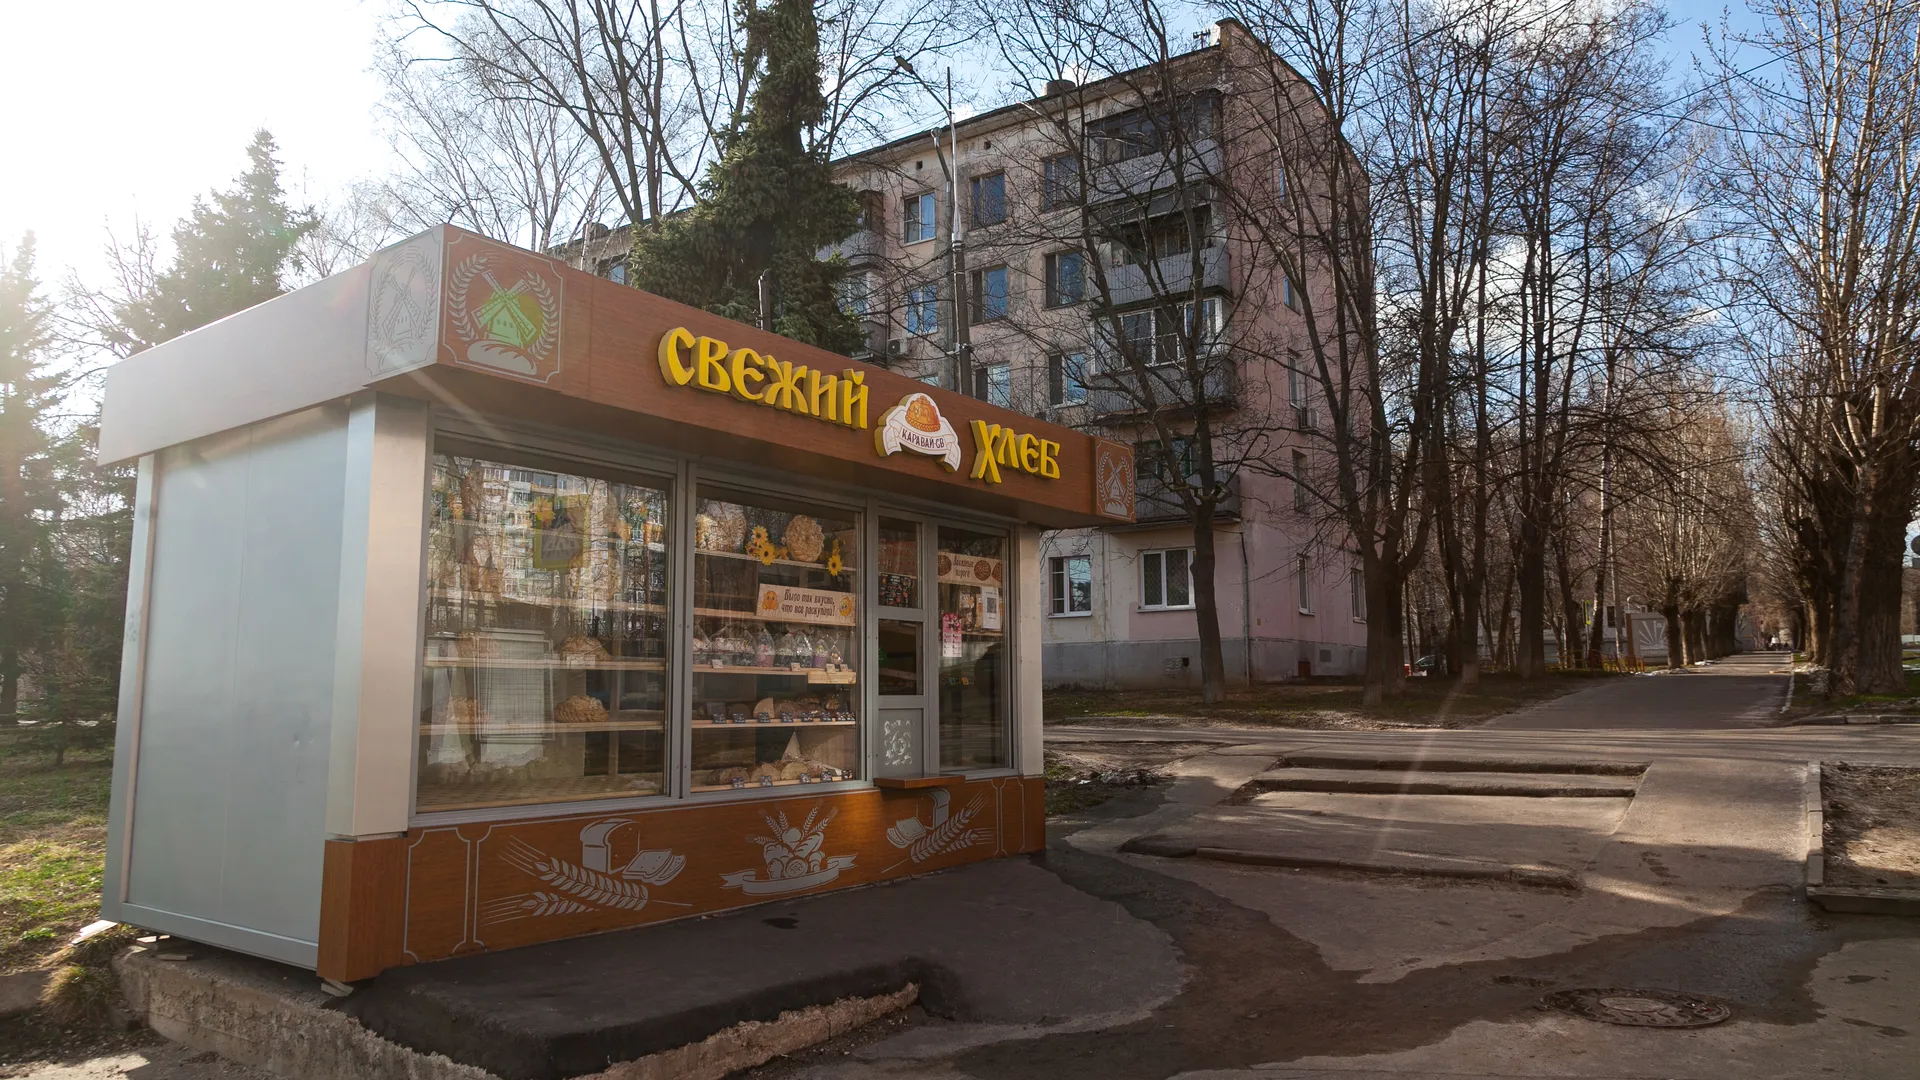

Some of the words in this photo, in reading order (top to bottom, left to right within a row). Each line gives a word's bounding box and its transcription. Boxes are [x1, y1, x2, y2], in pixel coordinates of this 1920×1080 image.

[659, 327, 869, 430] СВЕЖИЙ
[970, 420, 1060, 484] ХЛЕБ
[784, 589, 800, 601] Было
[801, 594, 813, 603] так
[781, 603, 793, 614] что
